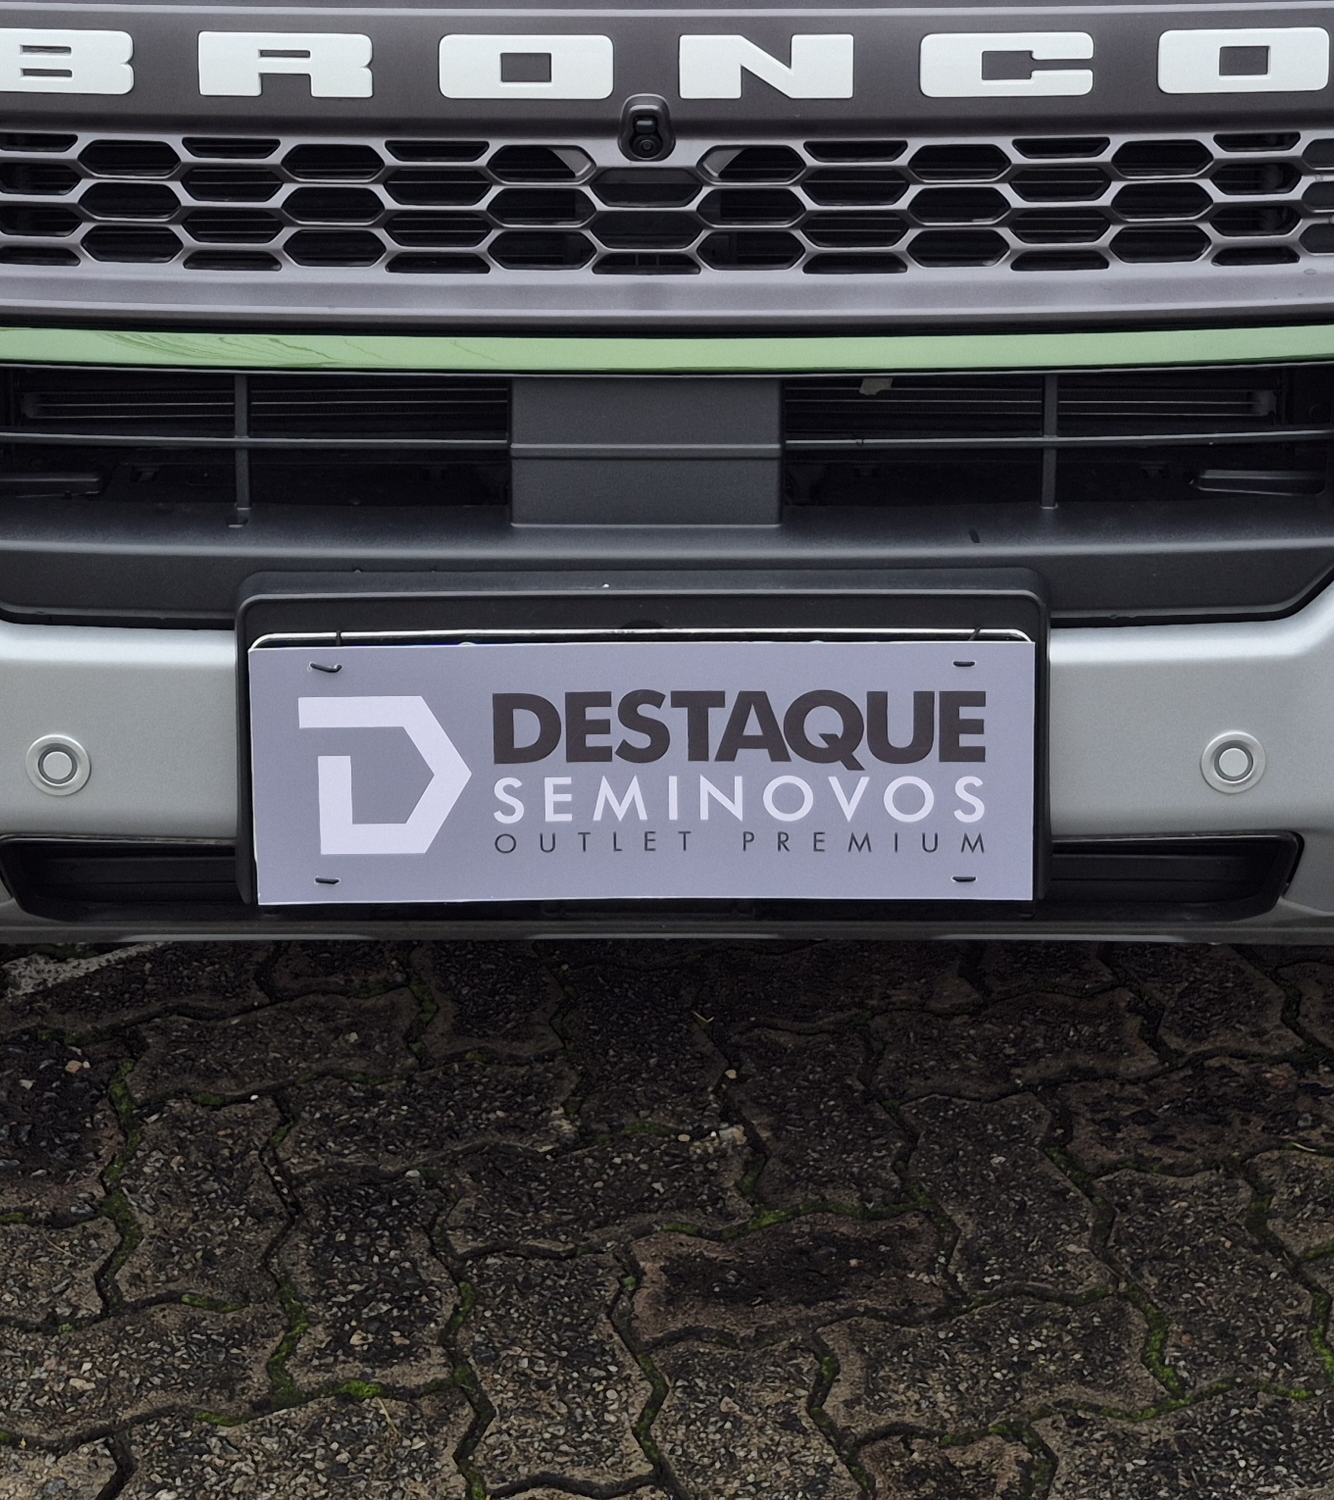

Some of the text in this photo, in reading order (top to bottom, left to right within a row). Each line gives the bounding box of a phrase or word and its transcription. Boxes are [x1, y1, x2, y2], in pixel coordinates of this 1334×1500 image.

[492, 689, 987, 771] DESTAQUE
[493, 775, 986, 823] SEMINOVOS
[494, 831, 986, 854] OUTLET PREMIUM
